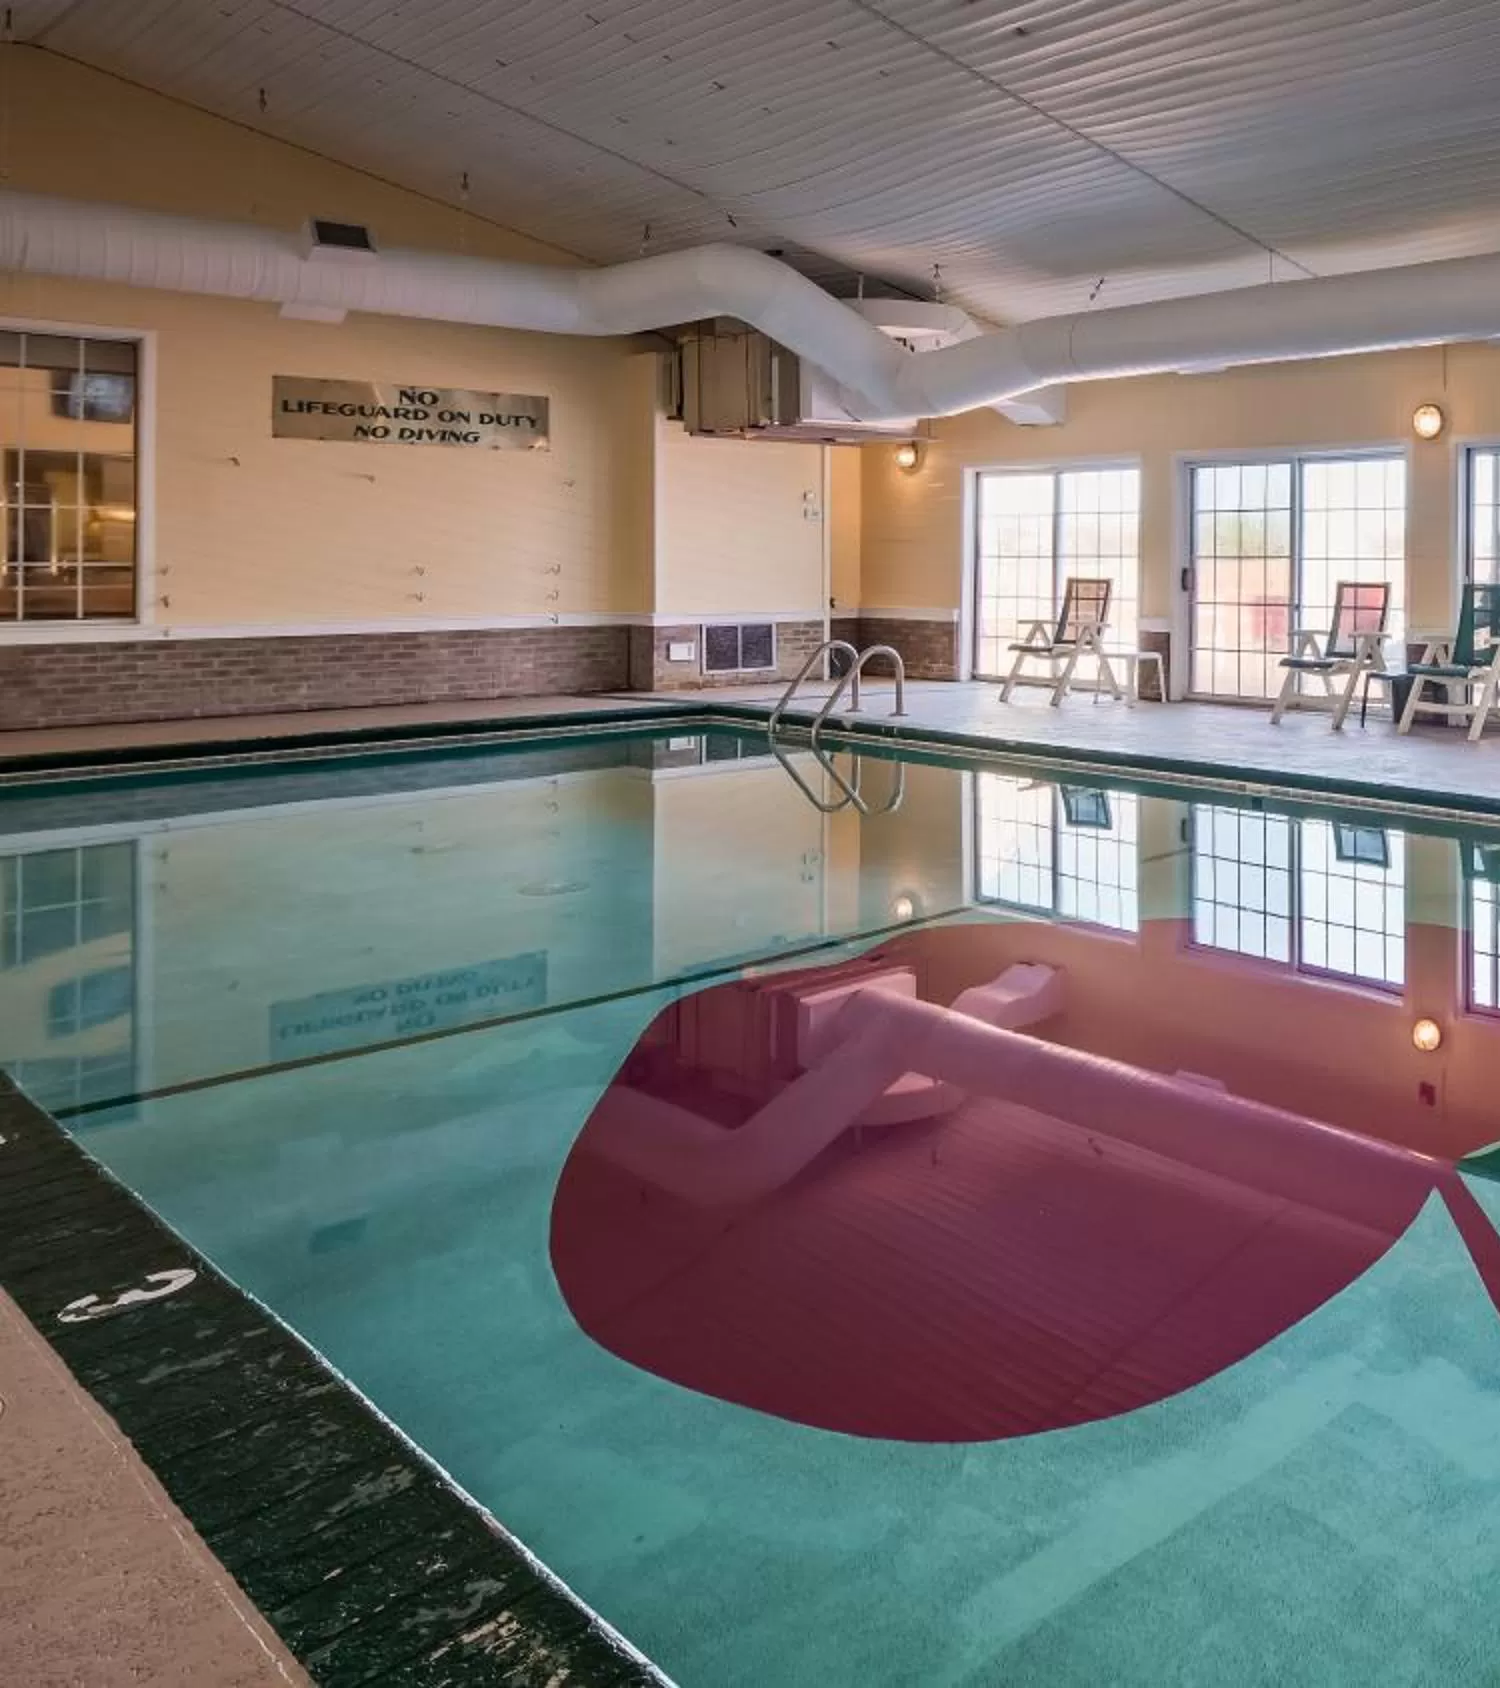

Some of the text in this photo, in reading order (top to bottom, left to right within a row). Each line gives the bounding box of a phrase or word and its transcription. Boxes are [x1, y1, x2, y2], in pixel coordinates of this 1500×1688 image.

[398, 389, 440, 406] NO
[281, 399, 541, 429] LIFEGUARD ON DUTY
[353, 425, 481, 444] NO DIVING
[56, 1268, 197, 1323] 3
